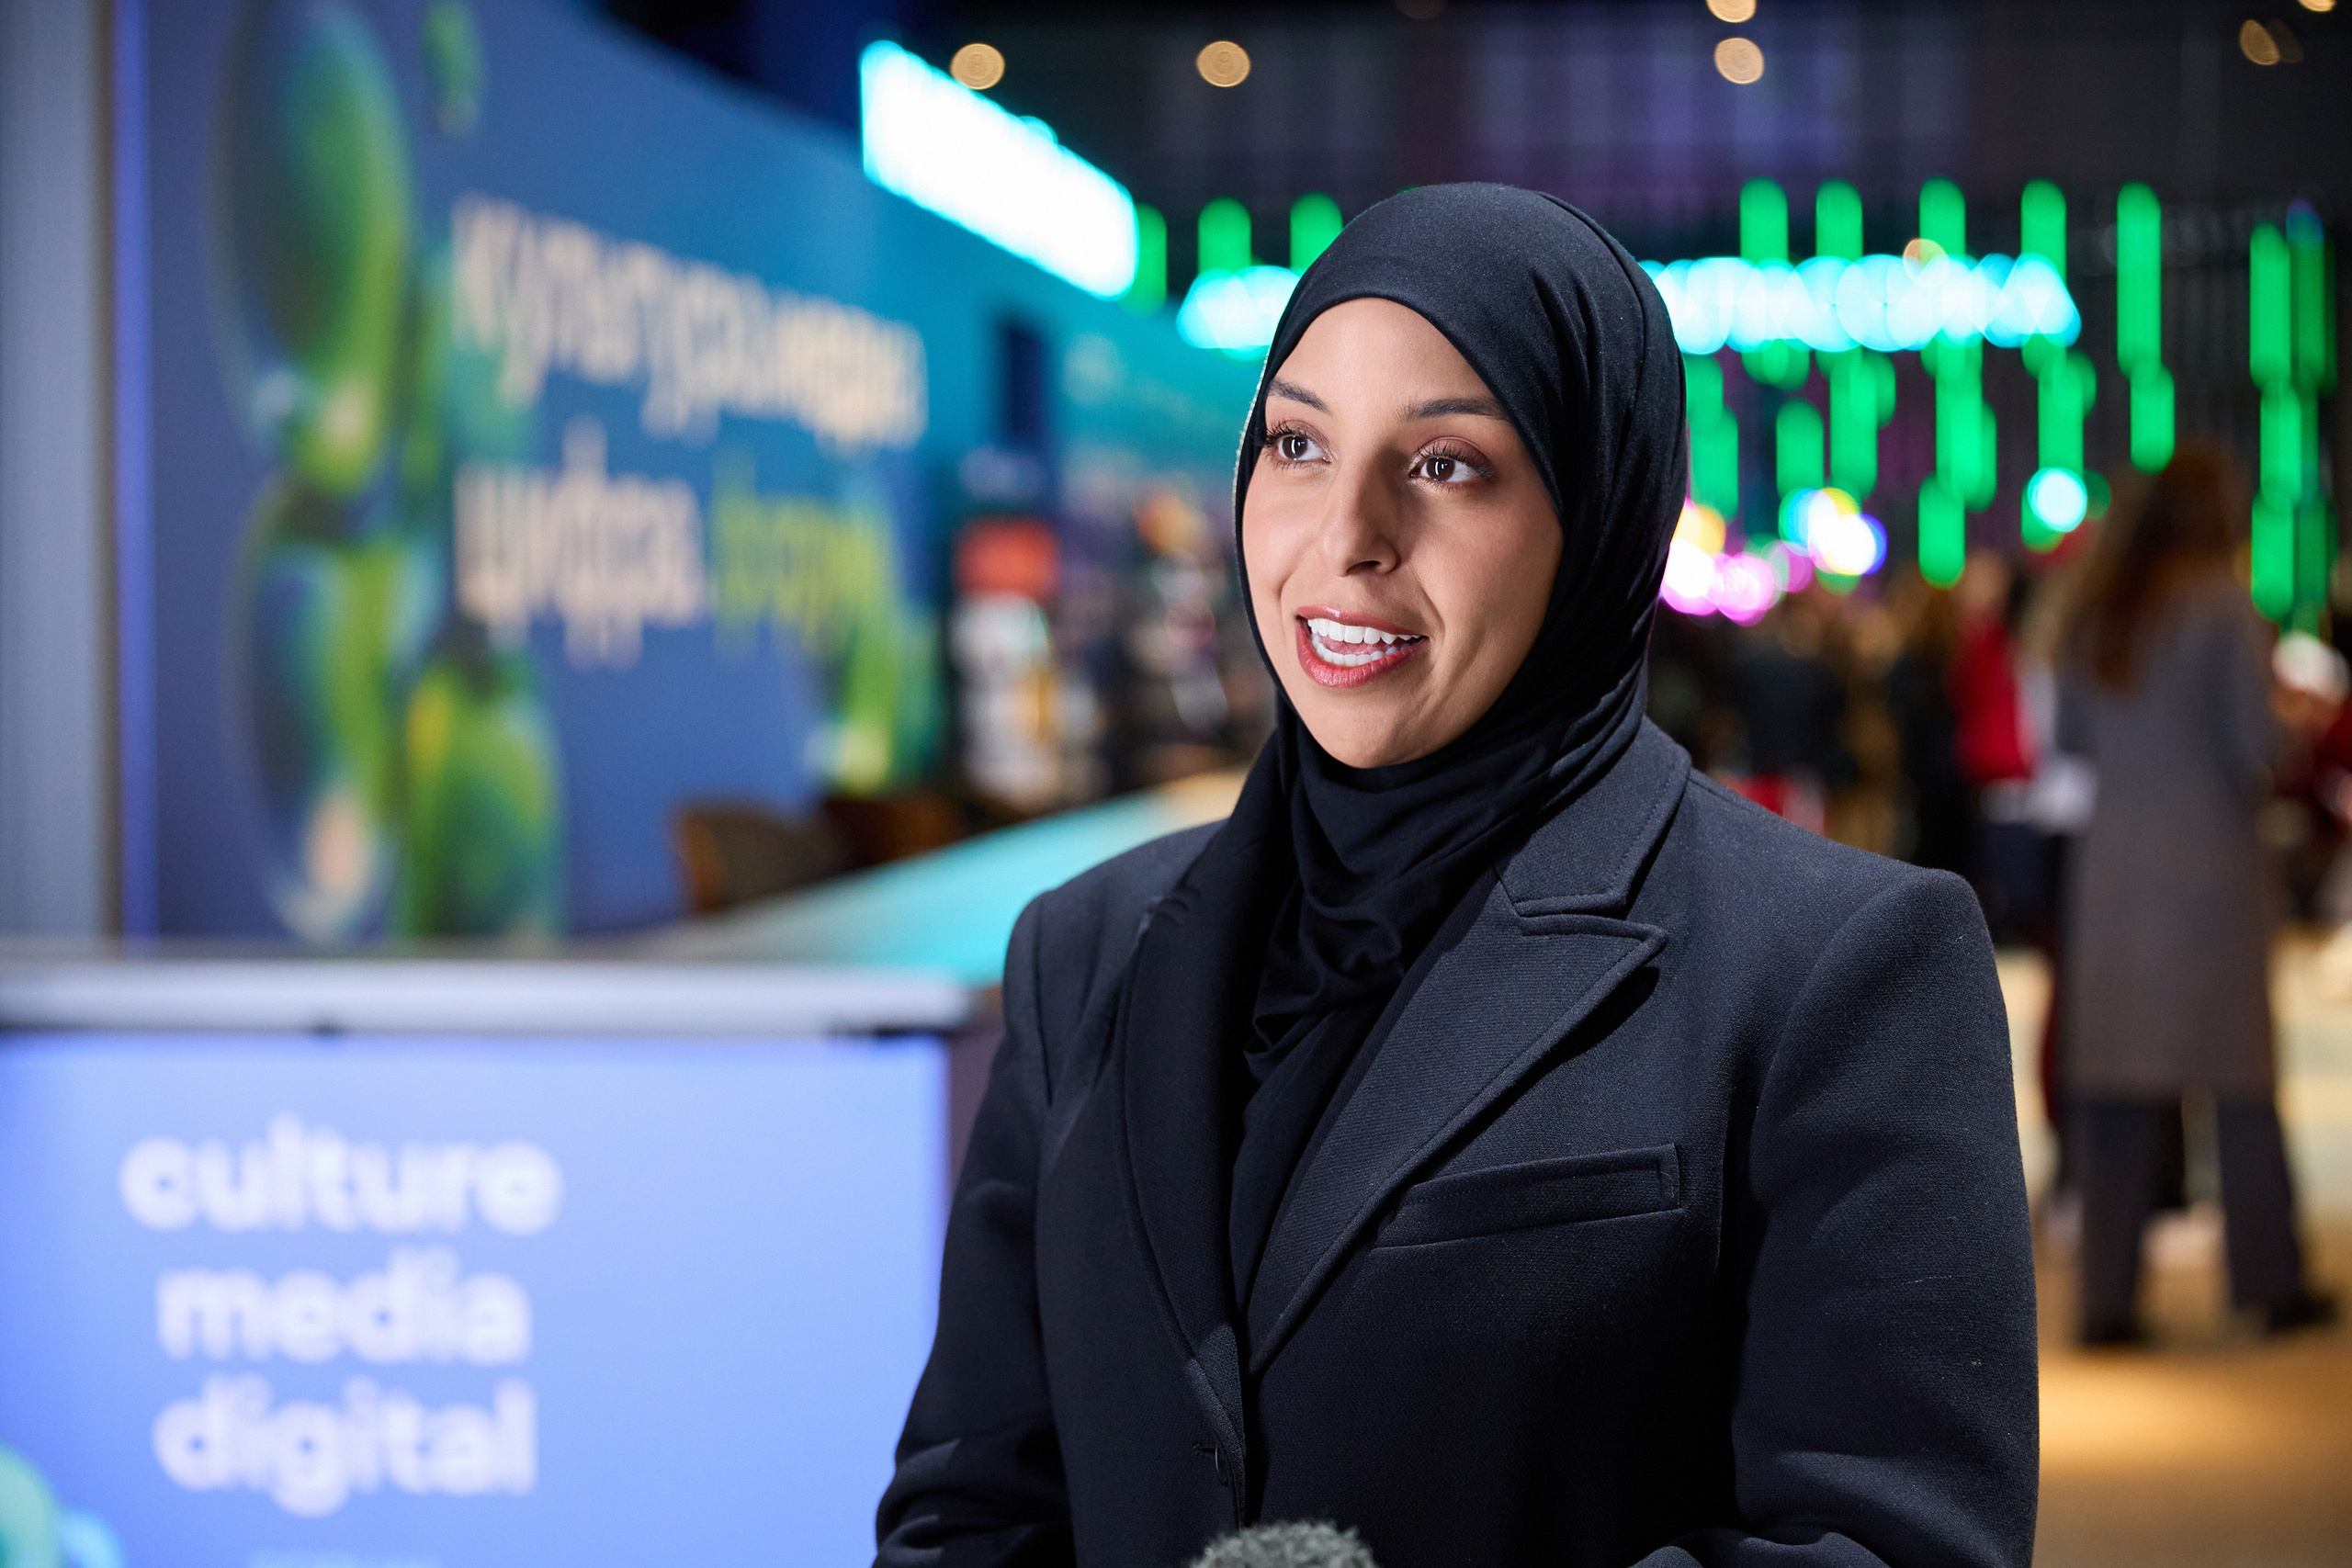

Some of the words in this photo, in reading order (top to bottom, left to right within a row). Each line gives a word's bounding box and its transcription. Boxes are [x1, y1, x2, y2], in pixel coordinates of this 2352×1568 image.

[120, 1113, 561, 1235] culture
[157, 1246, 532, 1365] media
[153, 1375, 538, 1516] digital
